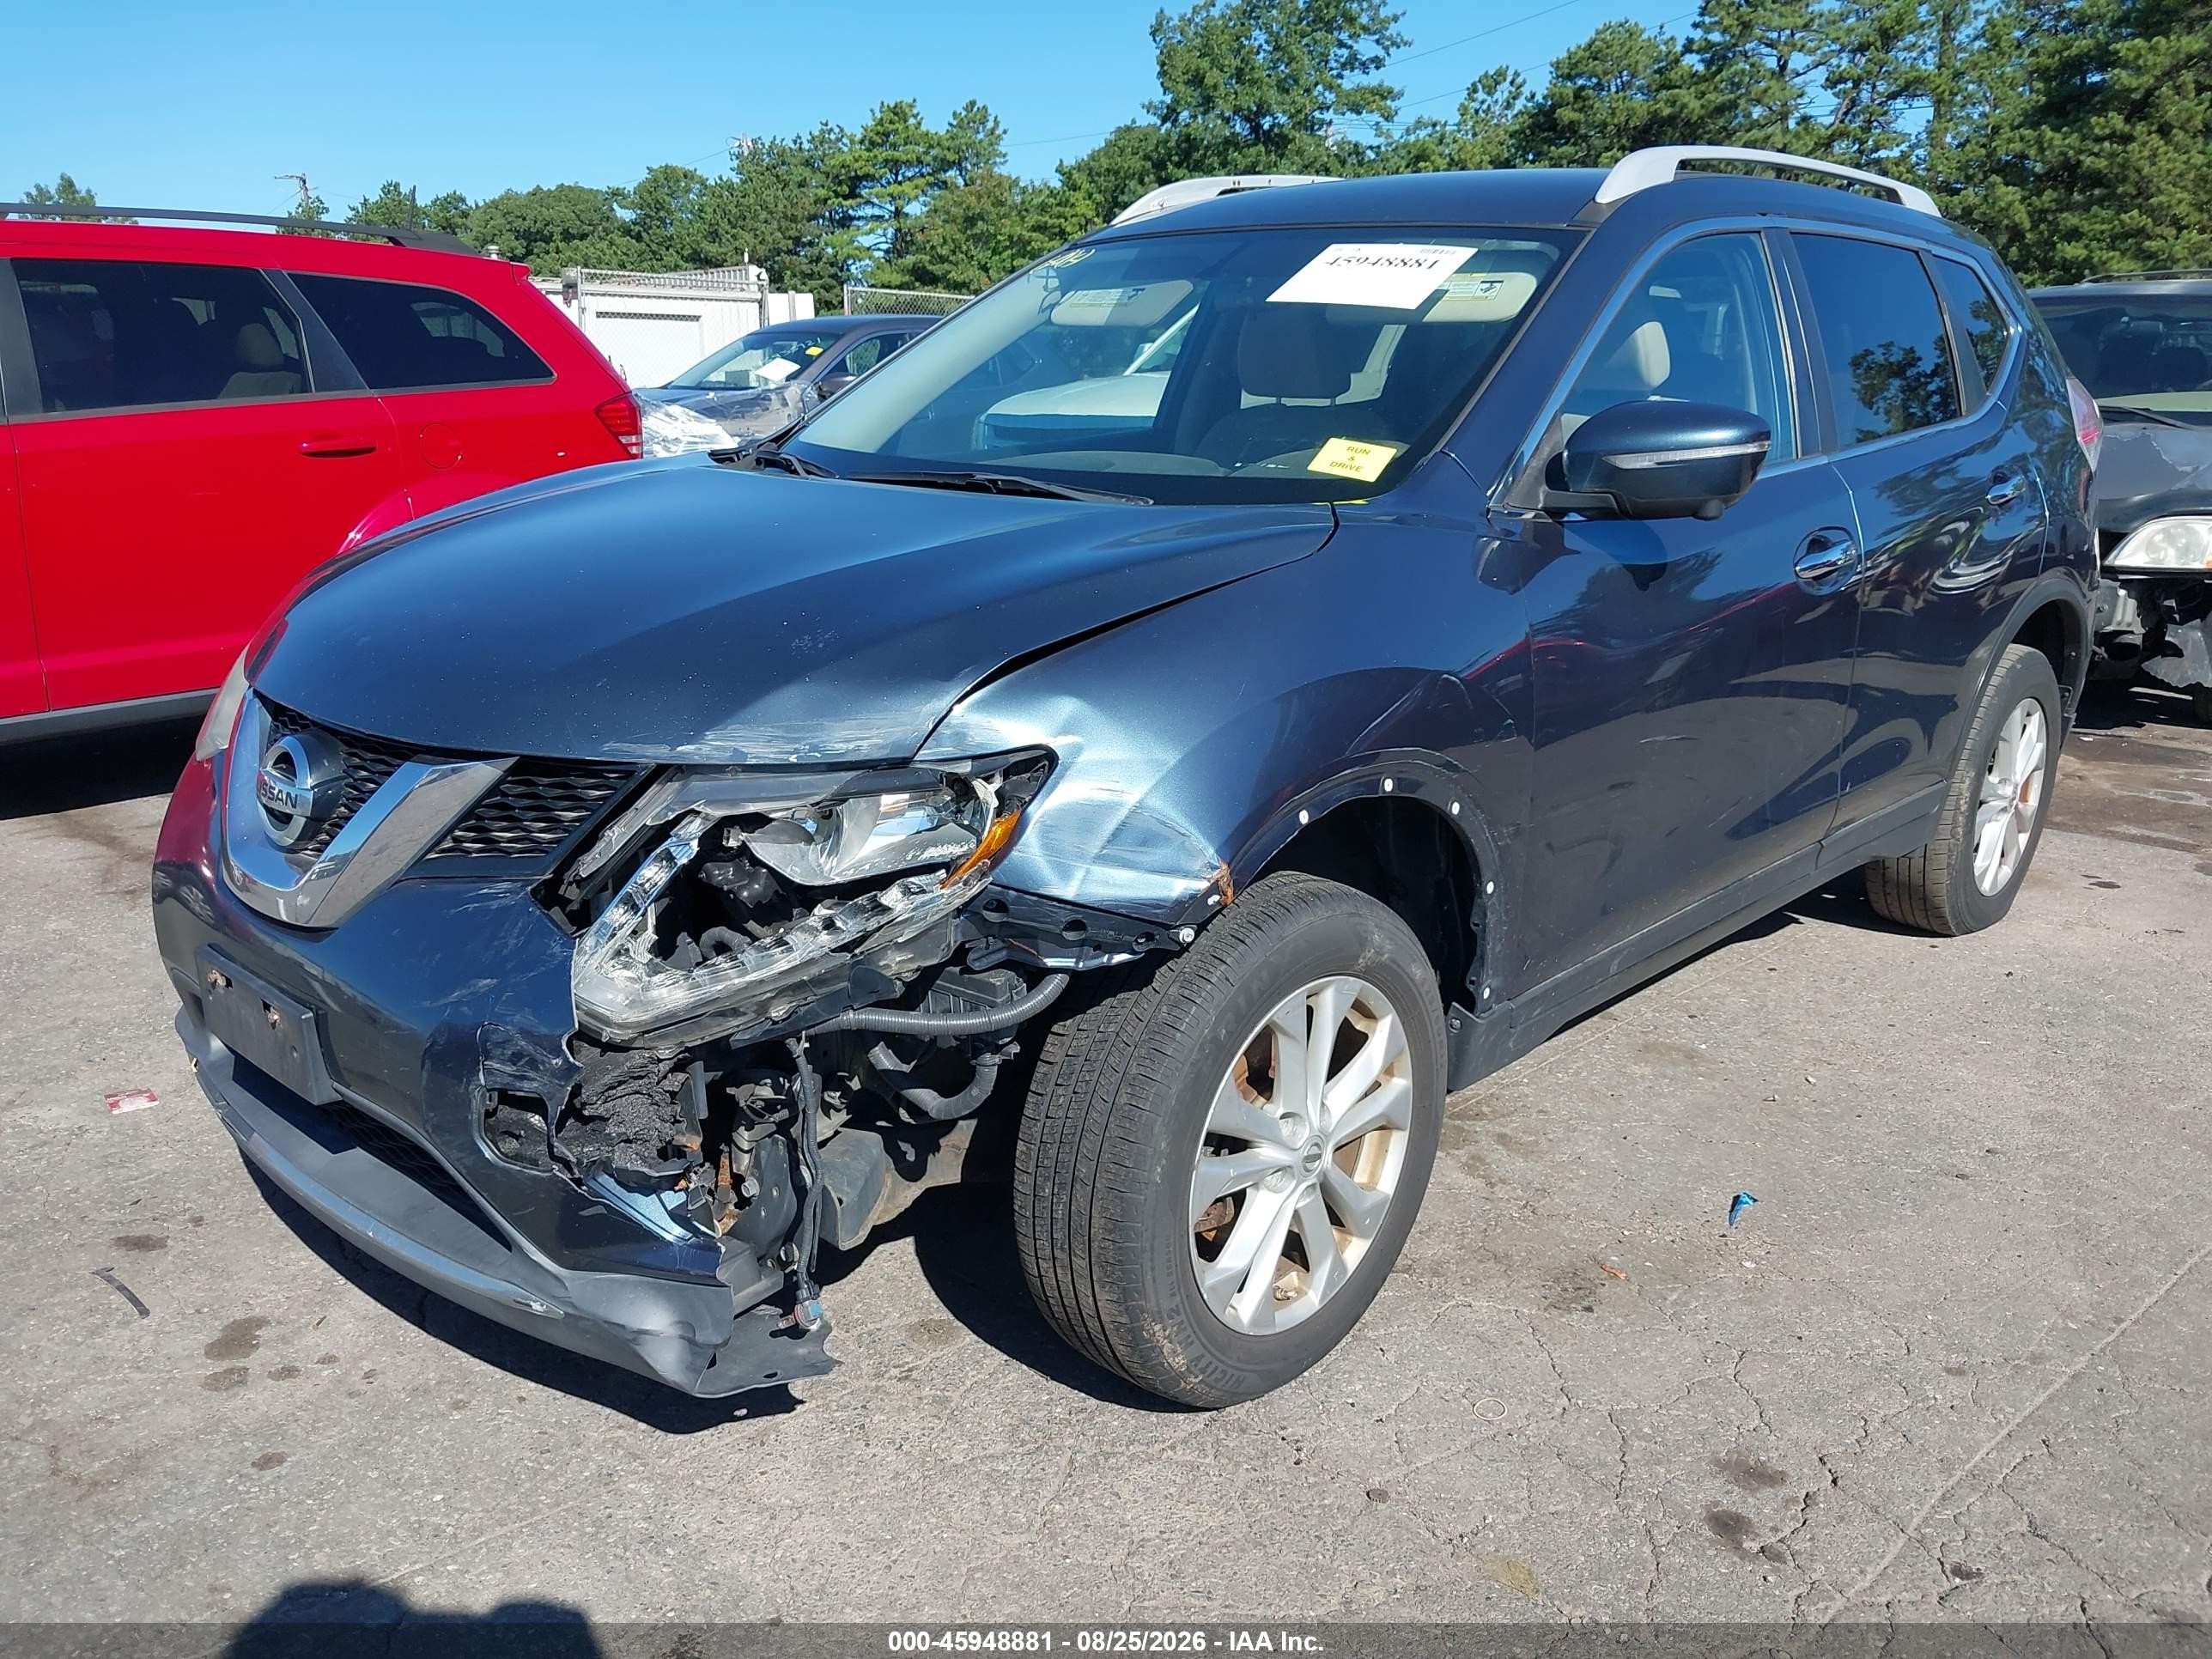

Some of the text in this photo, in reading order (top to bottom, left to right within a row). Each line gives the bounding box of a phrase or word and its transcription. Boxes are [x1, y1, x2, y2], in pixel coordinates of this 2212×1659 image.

[1325, 255, 1441, 270] 45948881
[1346, 446, 1371, 455] RUN
[1329, 461, 1364, 472] DRIVE
